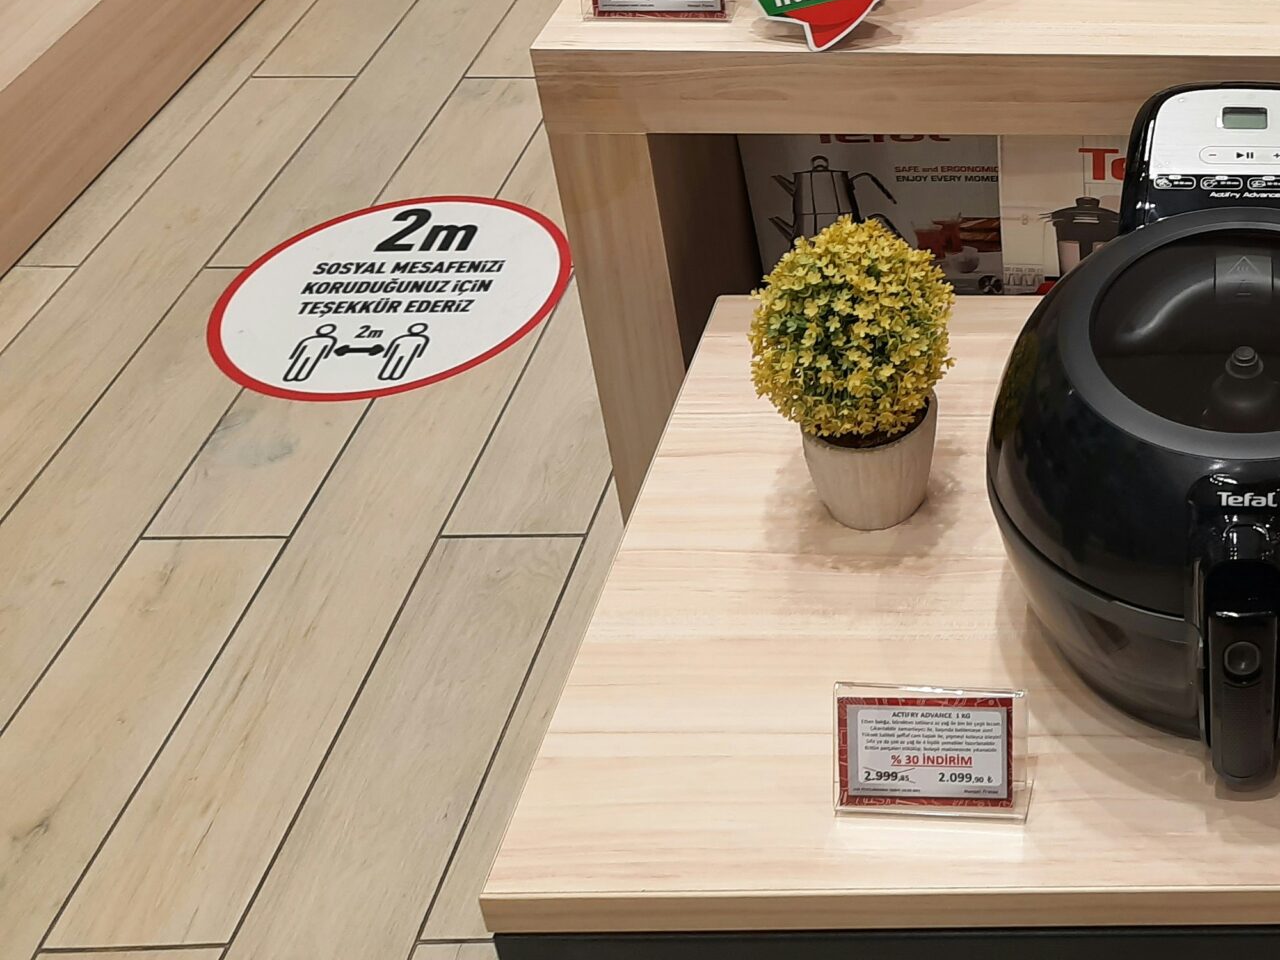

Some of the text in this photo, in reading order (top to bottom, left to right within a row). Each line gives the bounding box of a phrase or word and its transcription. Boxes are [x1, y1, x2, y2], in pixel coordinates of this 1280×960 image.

[373, 208, 478, 252] 2m
[312, 260, 506, 275] SOSYAL MESAFENİZİ
[301, 278, 494, 296] KORUDUĞUNUZ İÇİN
[298, 298, 475, 318] TEŞEKKÜR EDERİZ
[354, 324, 384, 339] 2m
[1217, 491, 1278, 507] Tefal
[891, 753, 973, 766] % 30 İNDİRİM
[938, 772, 984, 783] 2.099,90
